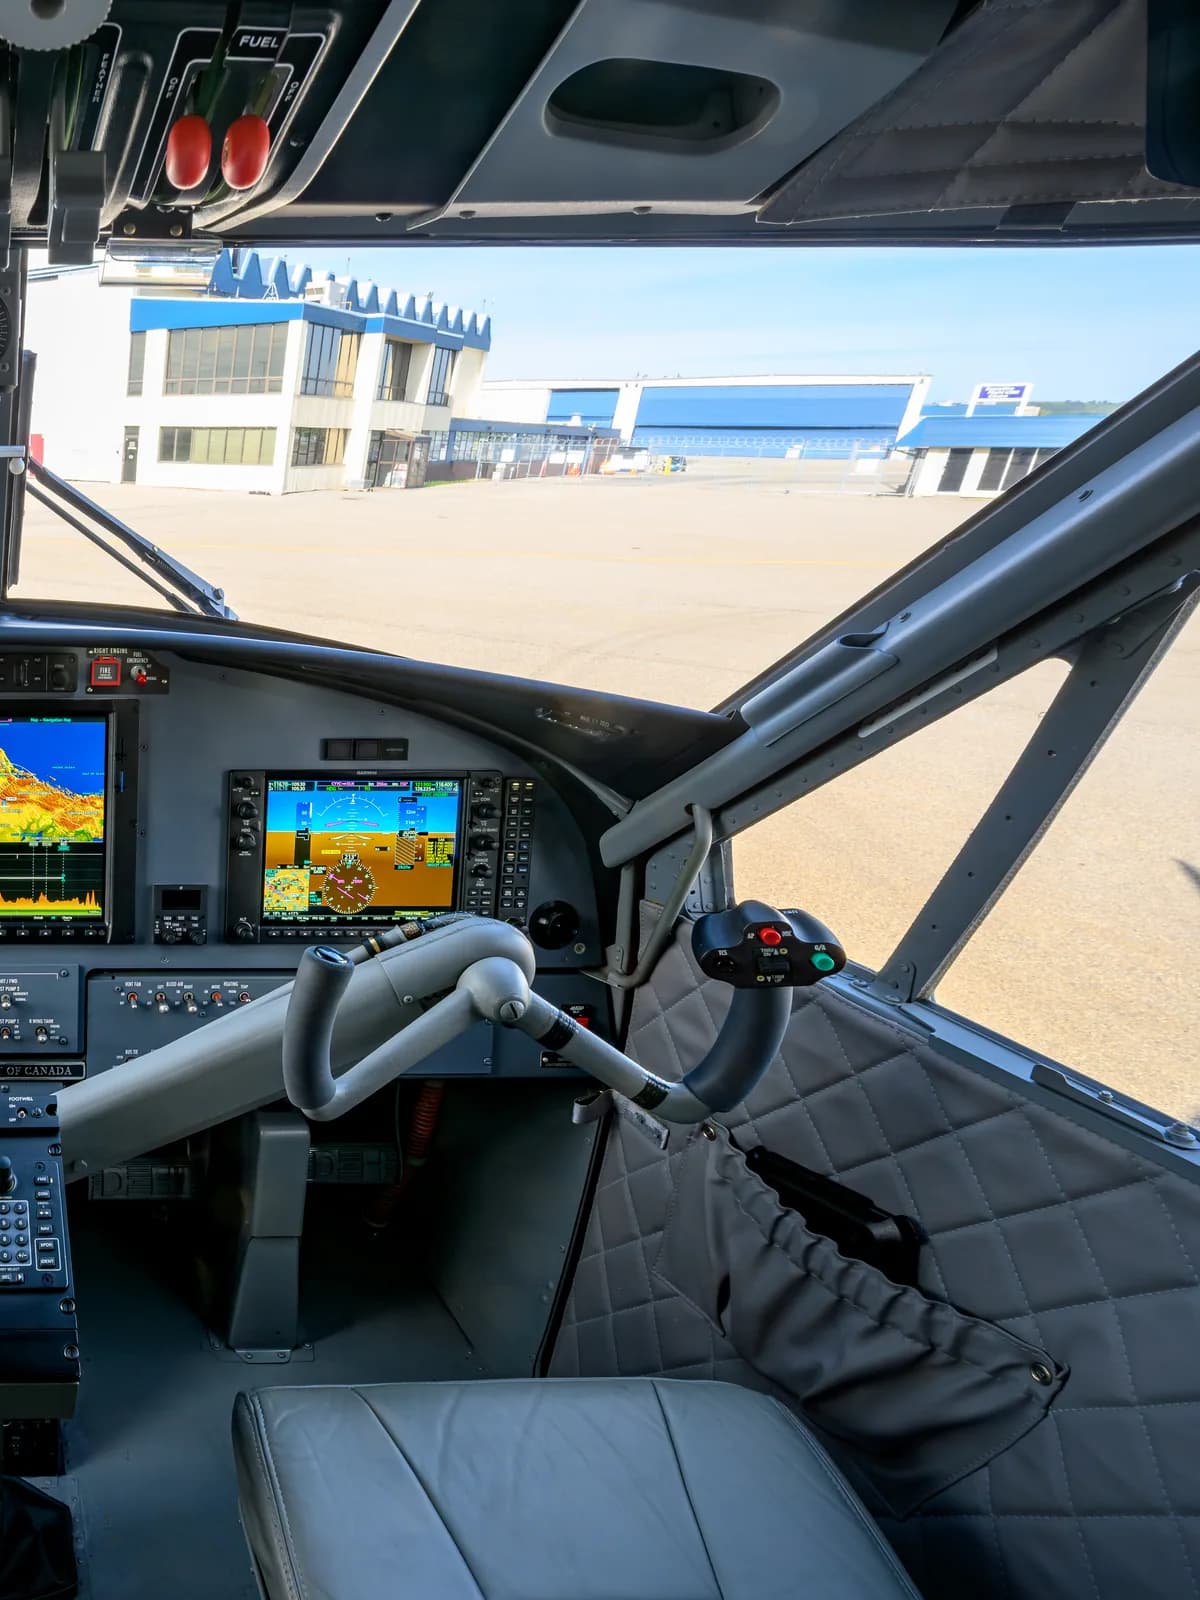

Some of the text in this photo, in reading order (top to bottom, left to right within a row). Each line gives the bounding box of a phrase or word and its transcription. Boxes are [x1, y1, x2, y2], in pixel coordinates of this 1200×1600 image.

[239, 35, 279, 48] FUEL
[92, 54, 109, 104] FEATHER
[166, 77, 178, 98] OFF
[284, 81, 299, 102] OFF
[6, 1064, 20, 1076] OF
[24, 1064, 72, 1075] CANADA
